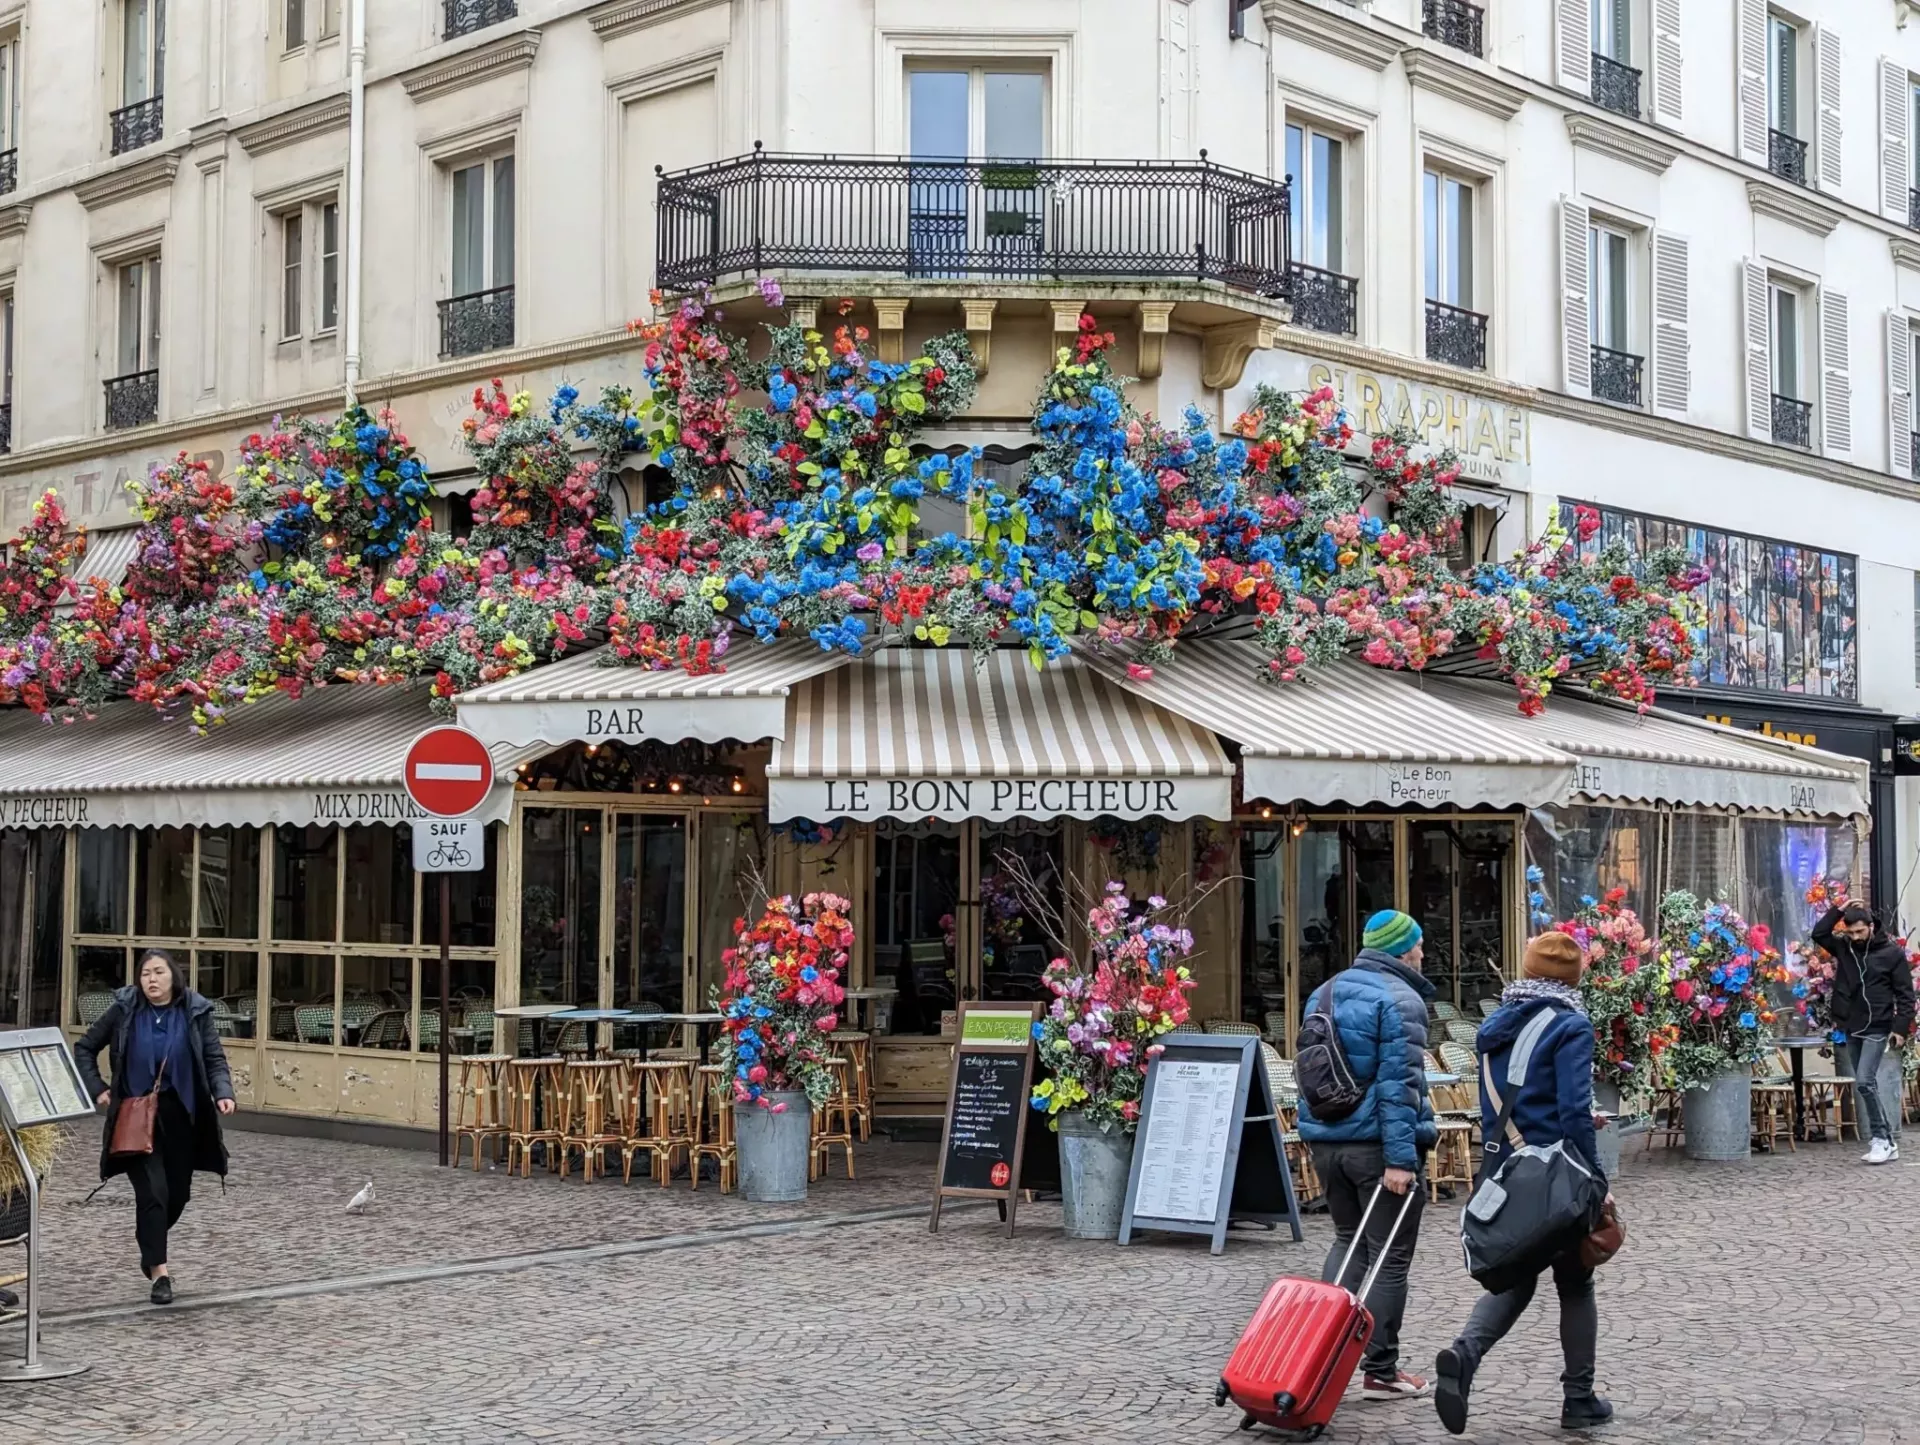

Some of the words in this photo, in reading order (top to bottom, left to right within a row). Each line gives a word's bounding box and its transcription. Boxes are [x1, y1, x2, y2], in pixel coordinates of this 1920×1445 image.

[585, 708, 645, 736] BAR
[1402, 766, 1420, 780] Le
[1425, 766, 1452, 781] Bon
[824, 780, 870, 812] LE
[887, 780, 973, 812] BON
[990, 780, 1178, 812] PECHEUR
[1391, 781, 1451, 800] Pecheur
[1790, 785, 1815, 809] BAR
[13, 797, 89, 823] PECHEUR
[314, 794, 352, 819] MIX
[430, 823, 468, 836] SAUF
